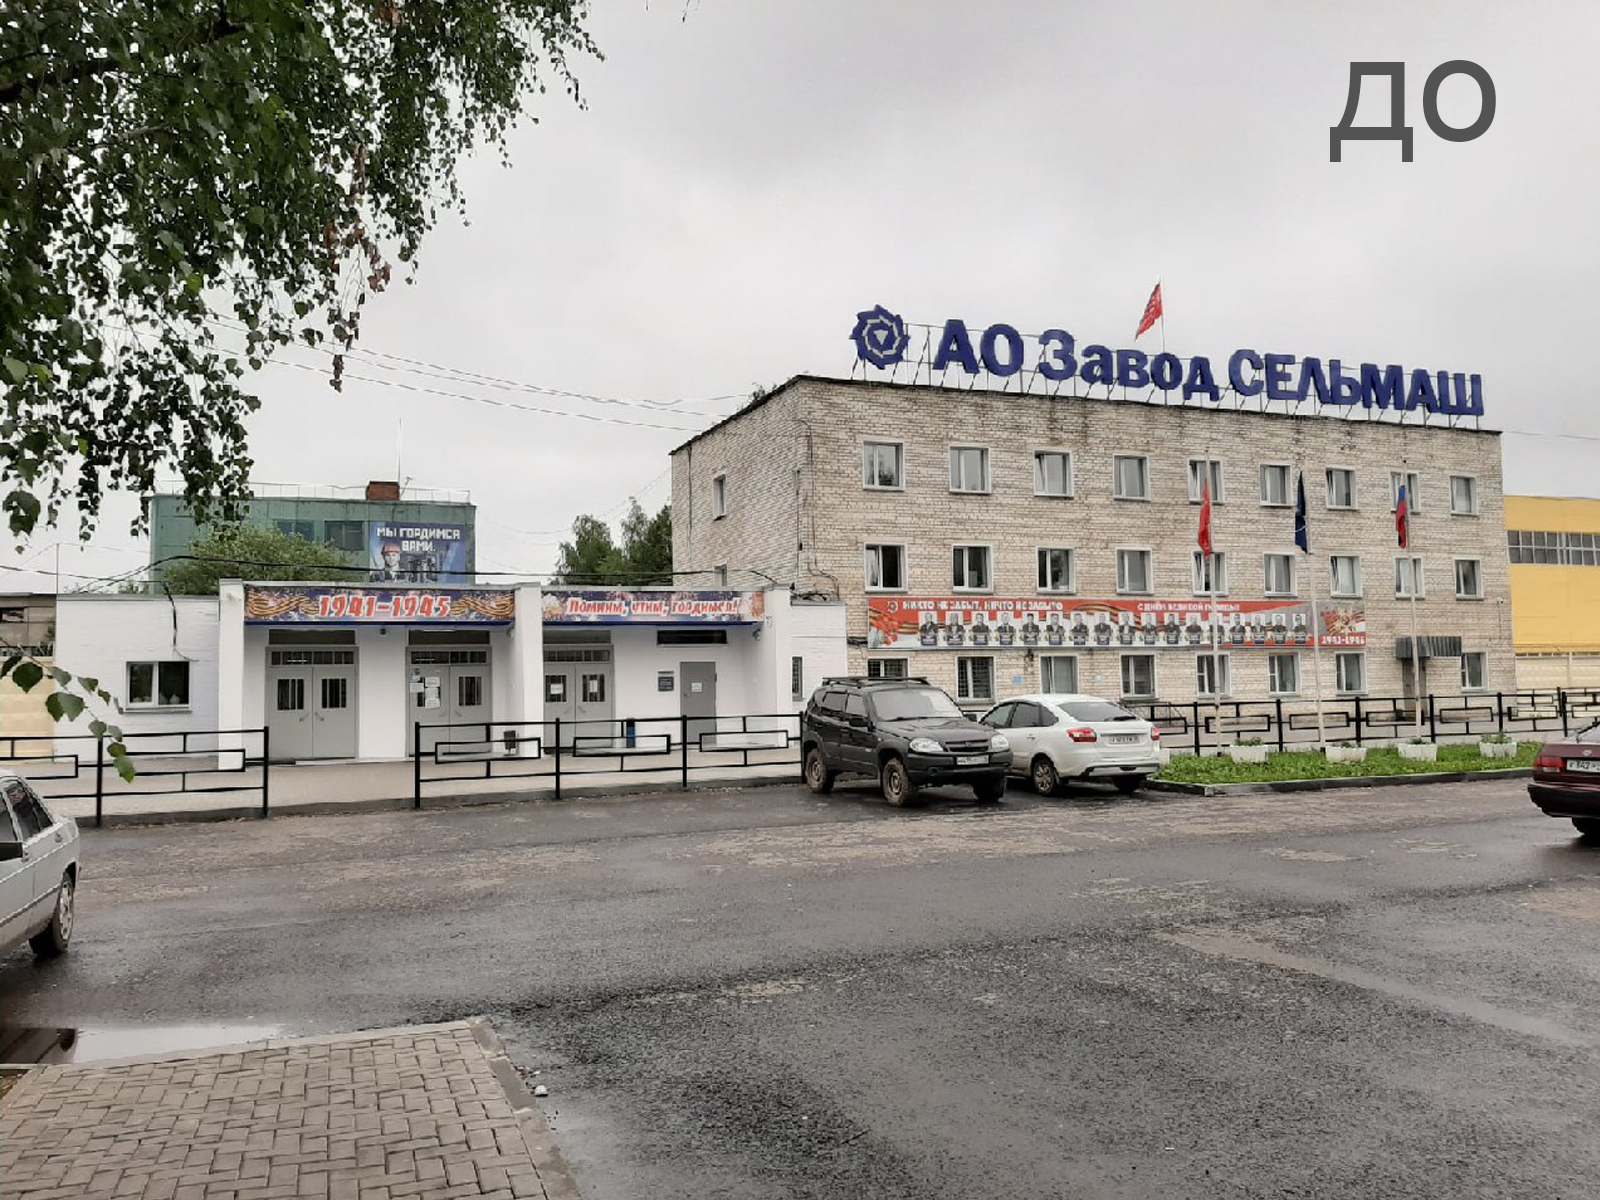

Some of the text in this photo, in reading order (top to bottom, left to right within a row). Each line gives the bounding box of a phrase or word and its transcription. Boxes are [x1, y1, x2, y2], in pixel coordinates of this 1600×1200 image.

[932, 319, 1486, 417] АО Завод СЕЛЬМАШ
[376, 526, 461, 540] МЫ ГОРДИМСЯ
[401, 540, 436, 552] ВАМИ.
[319, 595, 451, 618] 1941-1945
[903, 600, 935, 610] НИКТО
[984, 601, 1014, 610] НИЧТО
[1015, 601, 1027, 610] НЕ
